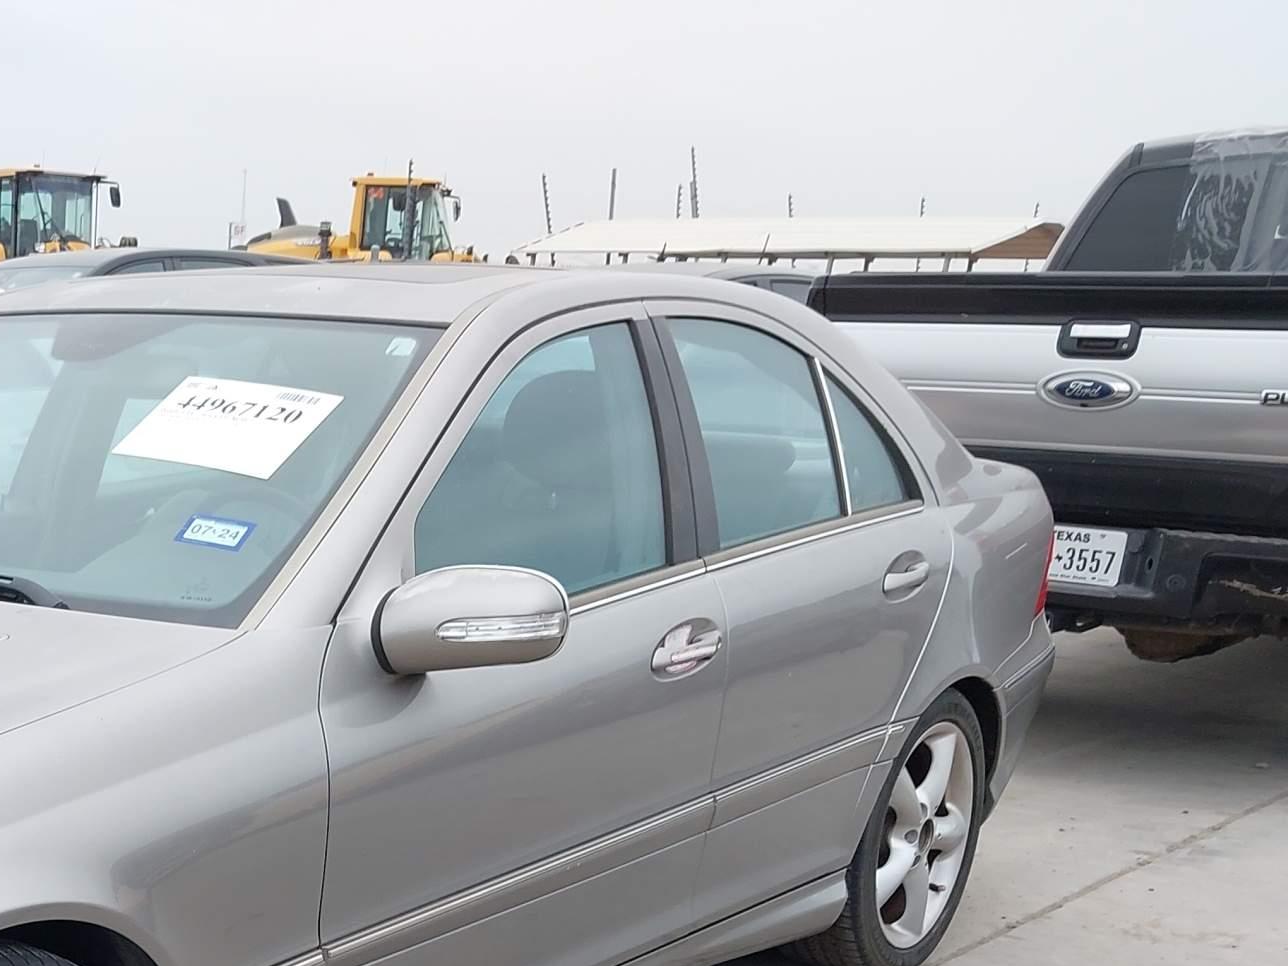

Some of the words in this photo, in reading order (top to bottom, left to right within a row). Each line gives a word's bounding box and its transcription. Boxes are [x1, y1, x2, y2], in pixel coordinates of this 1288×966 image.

[1064, 380, 1102, 398] Ford
[177, 395, 303, 424] 44967120
[1053, 530, 1091, 543] EXAS
